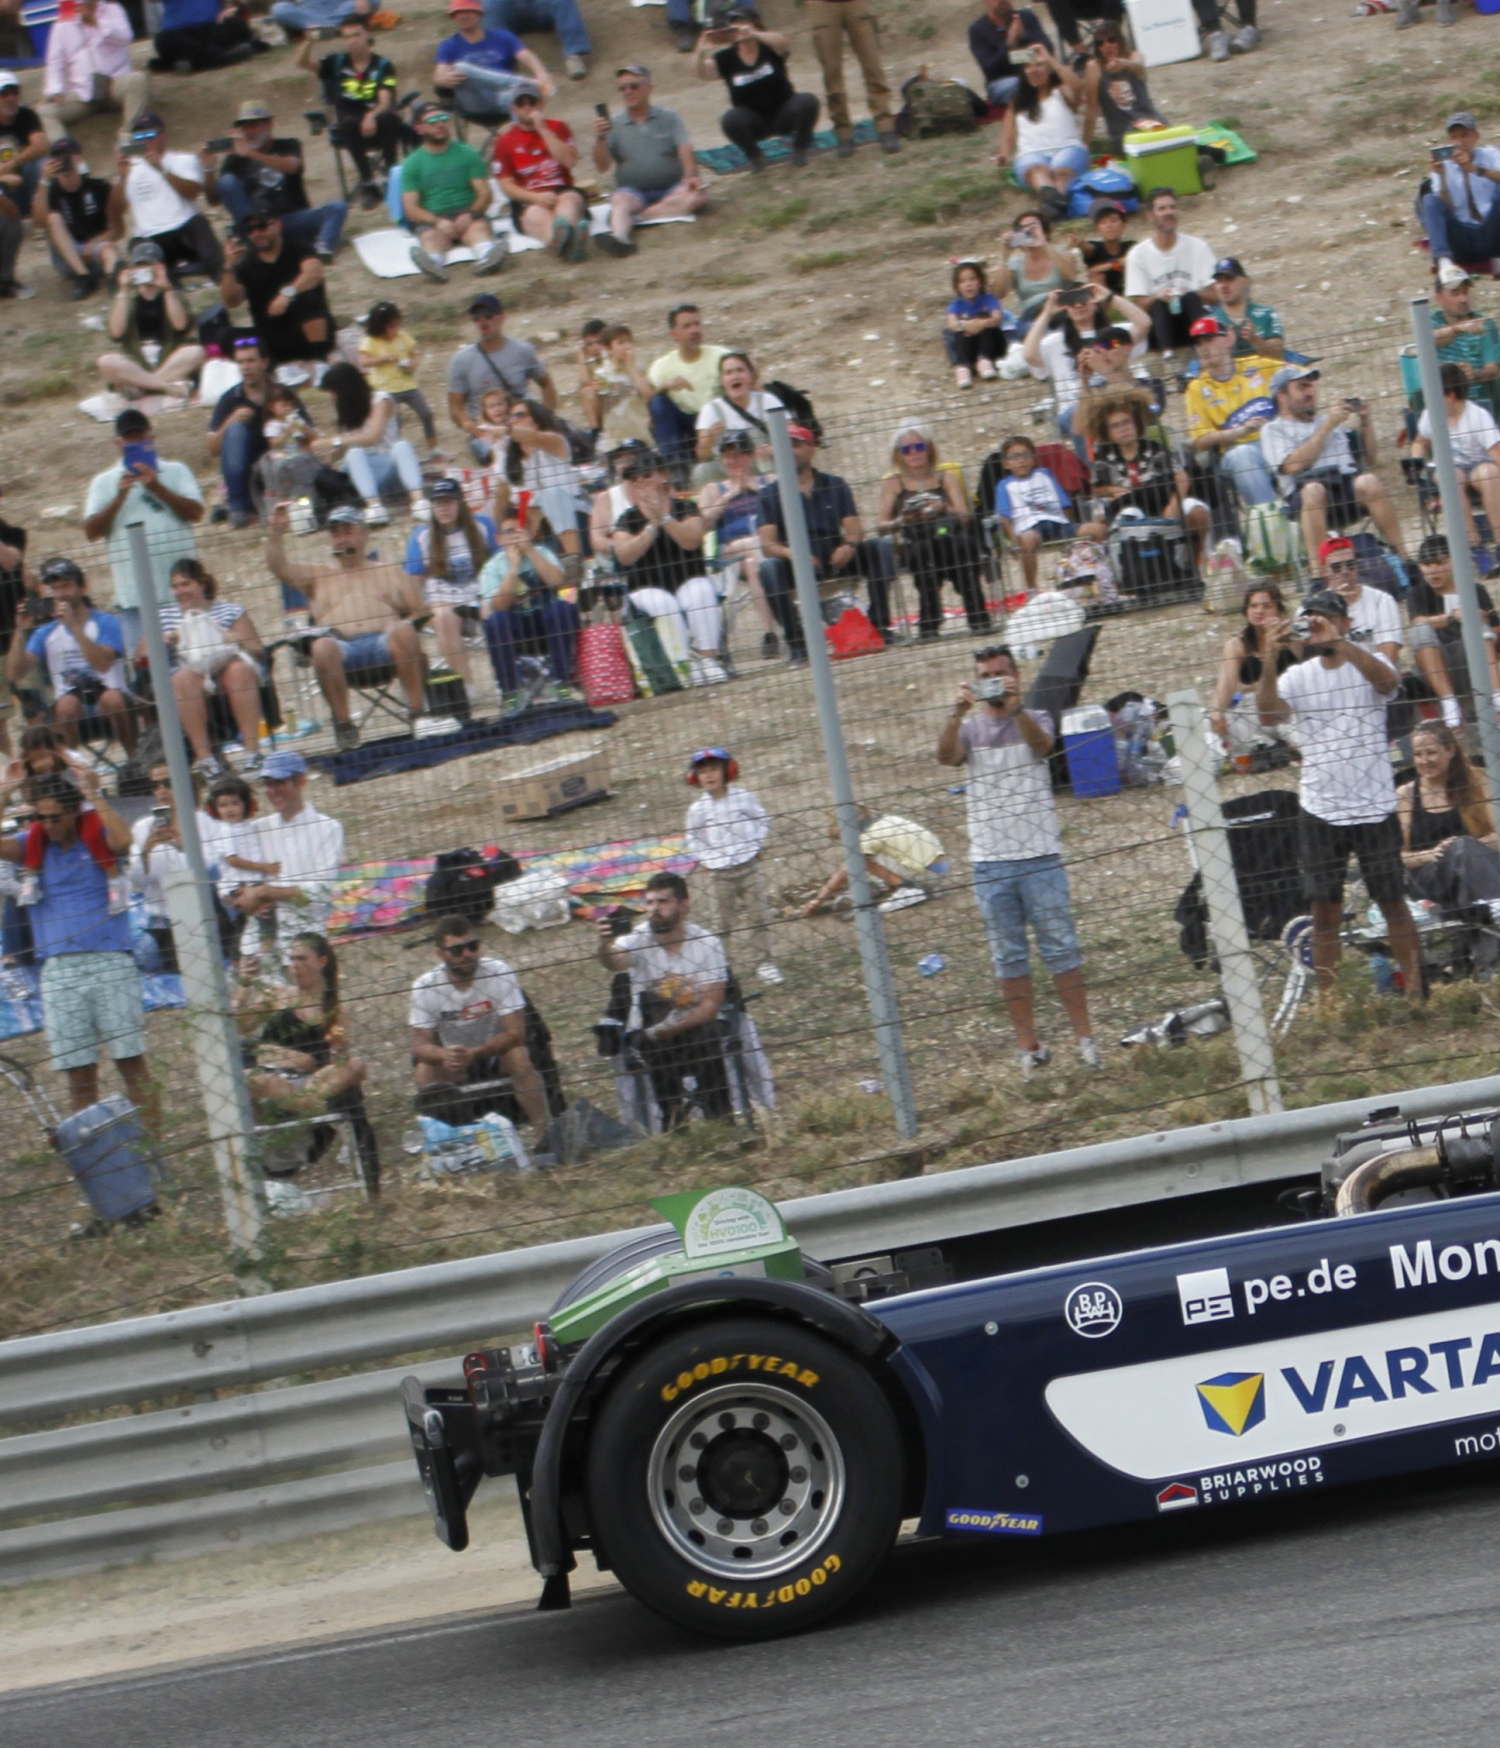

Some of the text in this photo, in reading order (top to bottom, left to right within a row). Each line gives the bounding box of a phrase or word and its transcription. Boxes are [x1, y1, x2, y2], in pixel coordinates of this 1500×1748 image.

[1243, 1258, 1357, 1315] pe.de
[661, 1354, 820, 1402] GOODYEAR
[1200, 1457, 1322, 1491] BRIARWOOD
[1203, 1472, 1324, 1503] SUPPLIES
[948, 1513, 1039, 1530] GOODYEAR
